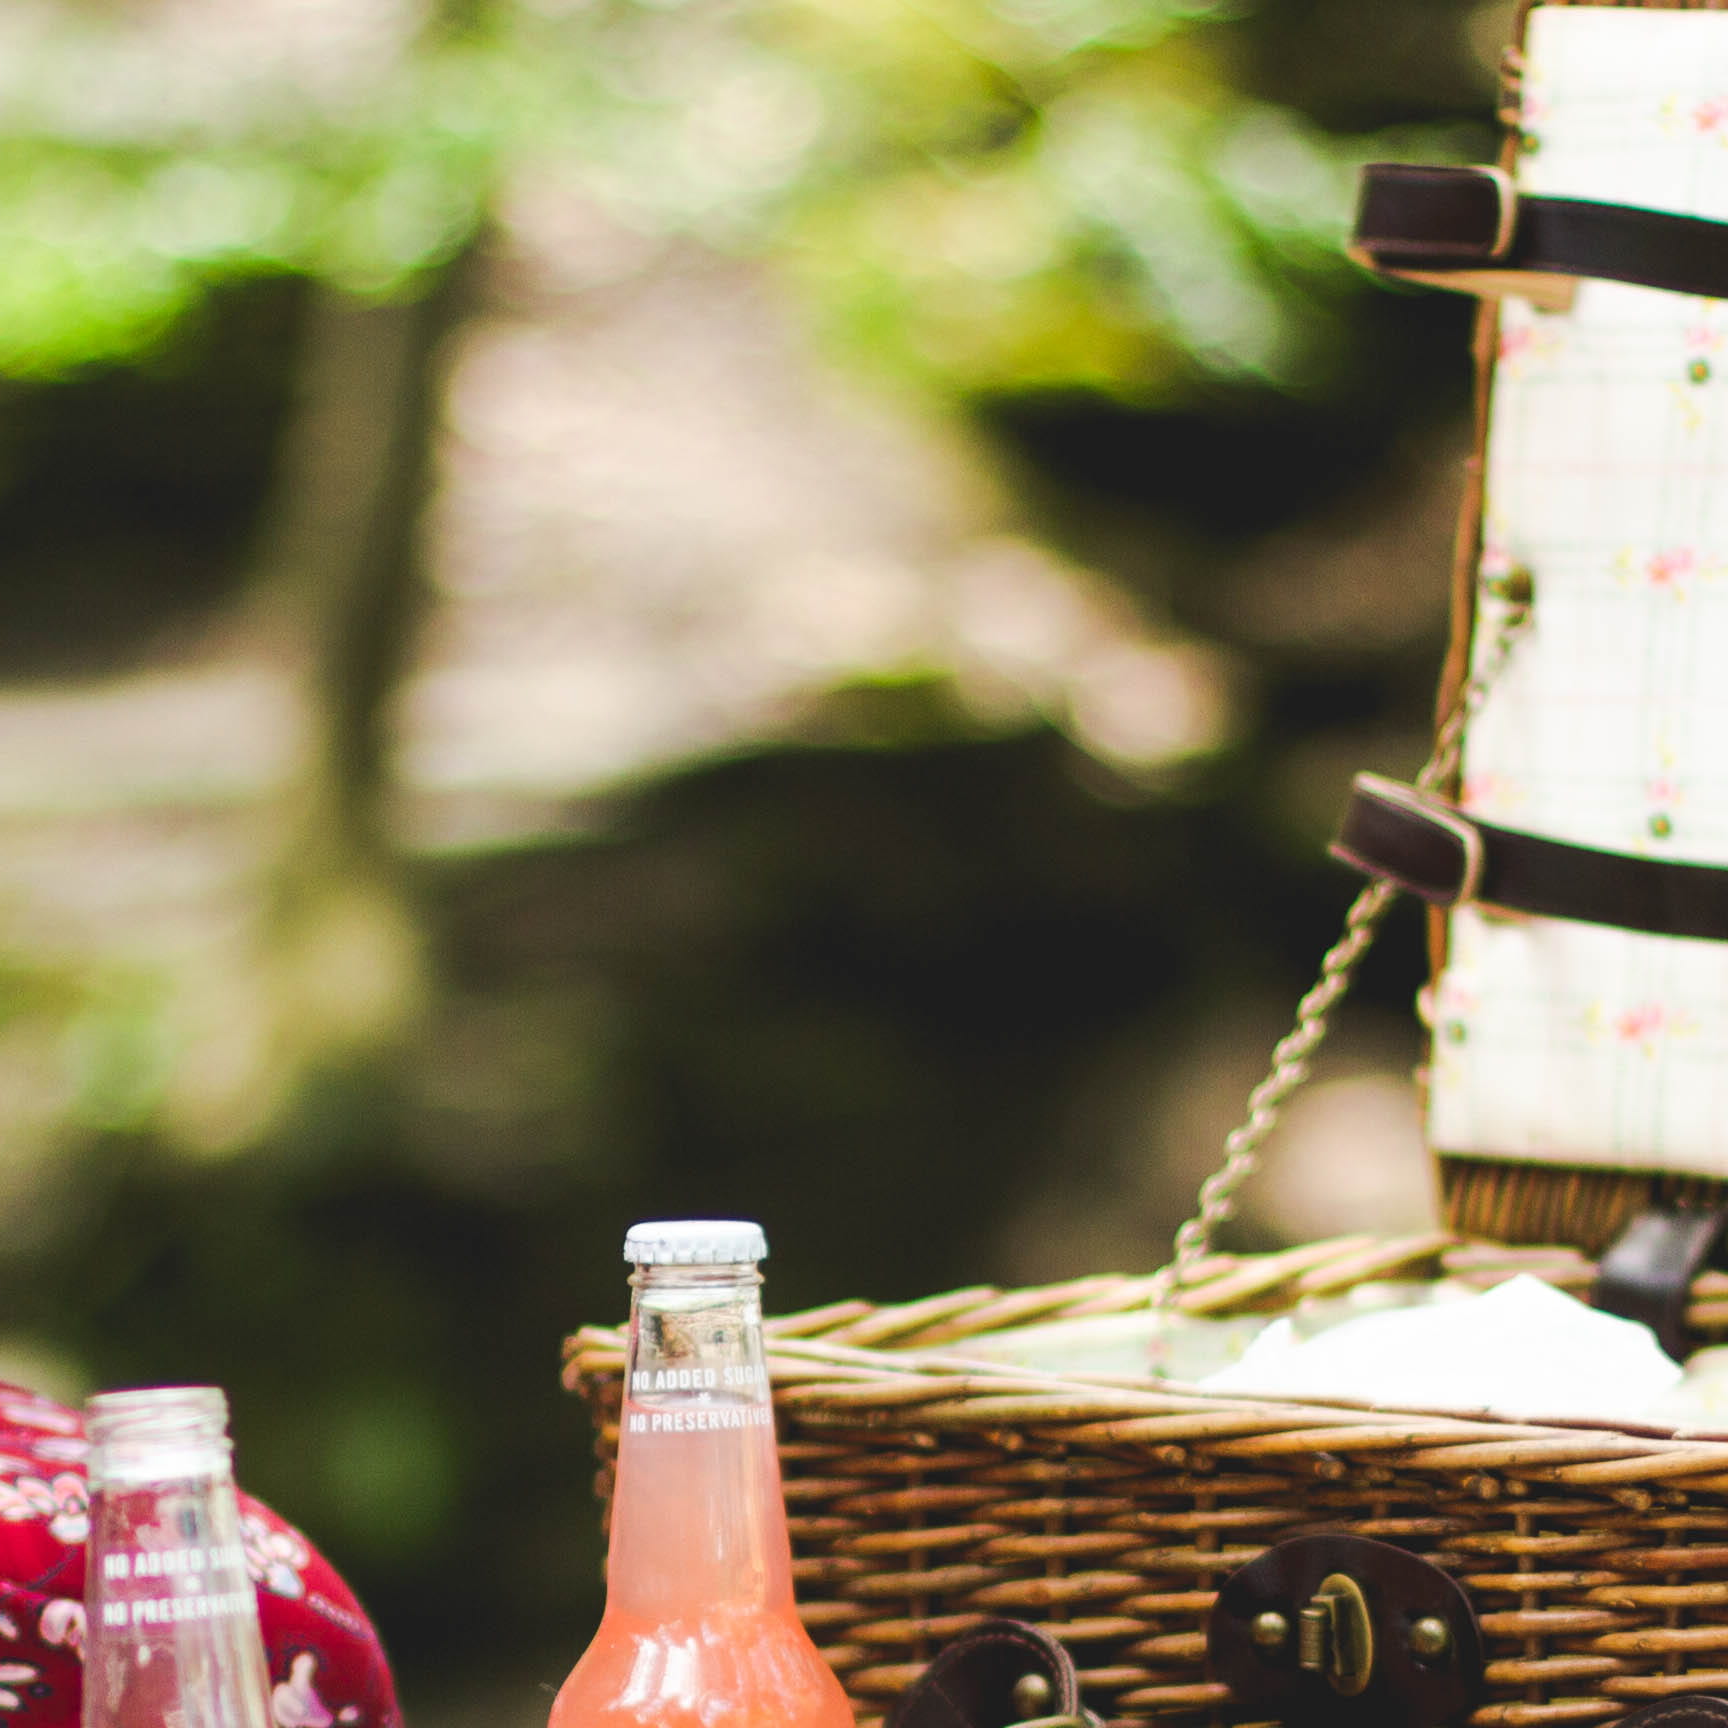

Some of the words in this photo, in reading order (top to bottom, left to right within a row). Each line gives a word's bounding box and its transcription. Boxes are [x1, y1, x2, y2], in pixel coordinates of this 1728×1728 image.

[631, 1371, 650, 1391] NO
[655, 1368, 717, 1389] ADDED
[629, 1413, 647, 1433] NO
[104, 1553, 129, 1580] NO
[103, 1602, 128, 1626] NO
